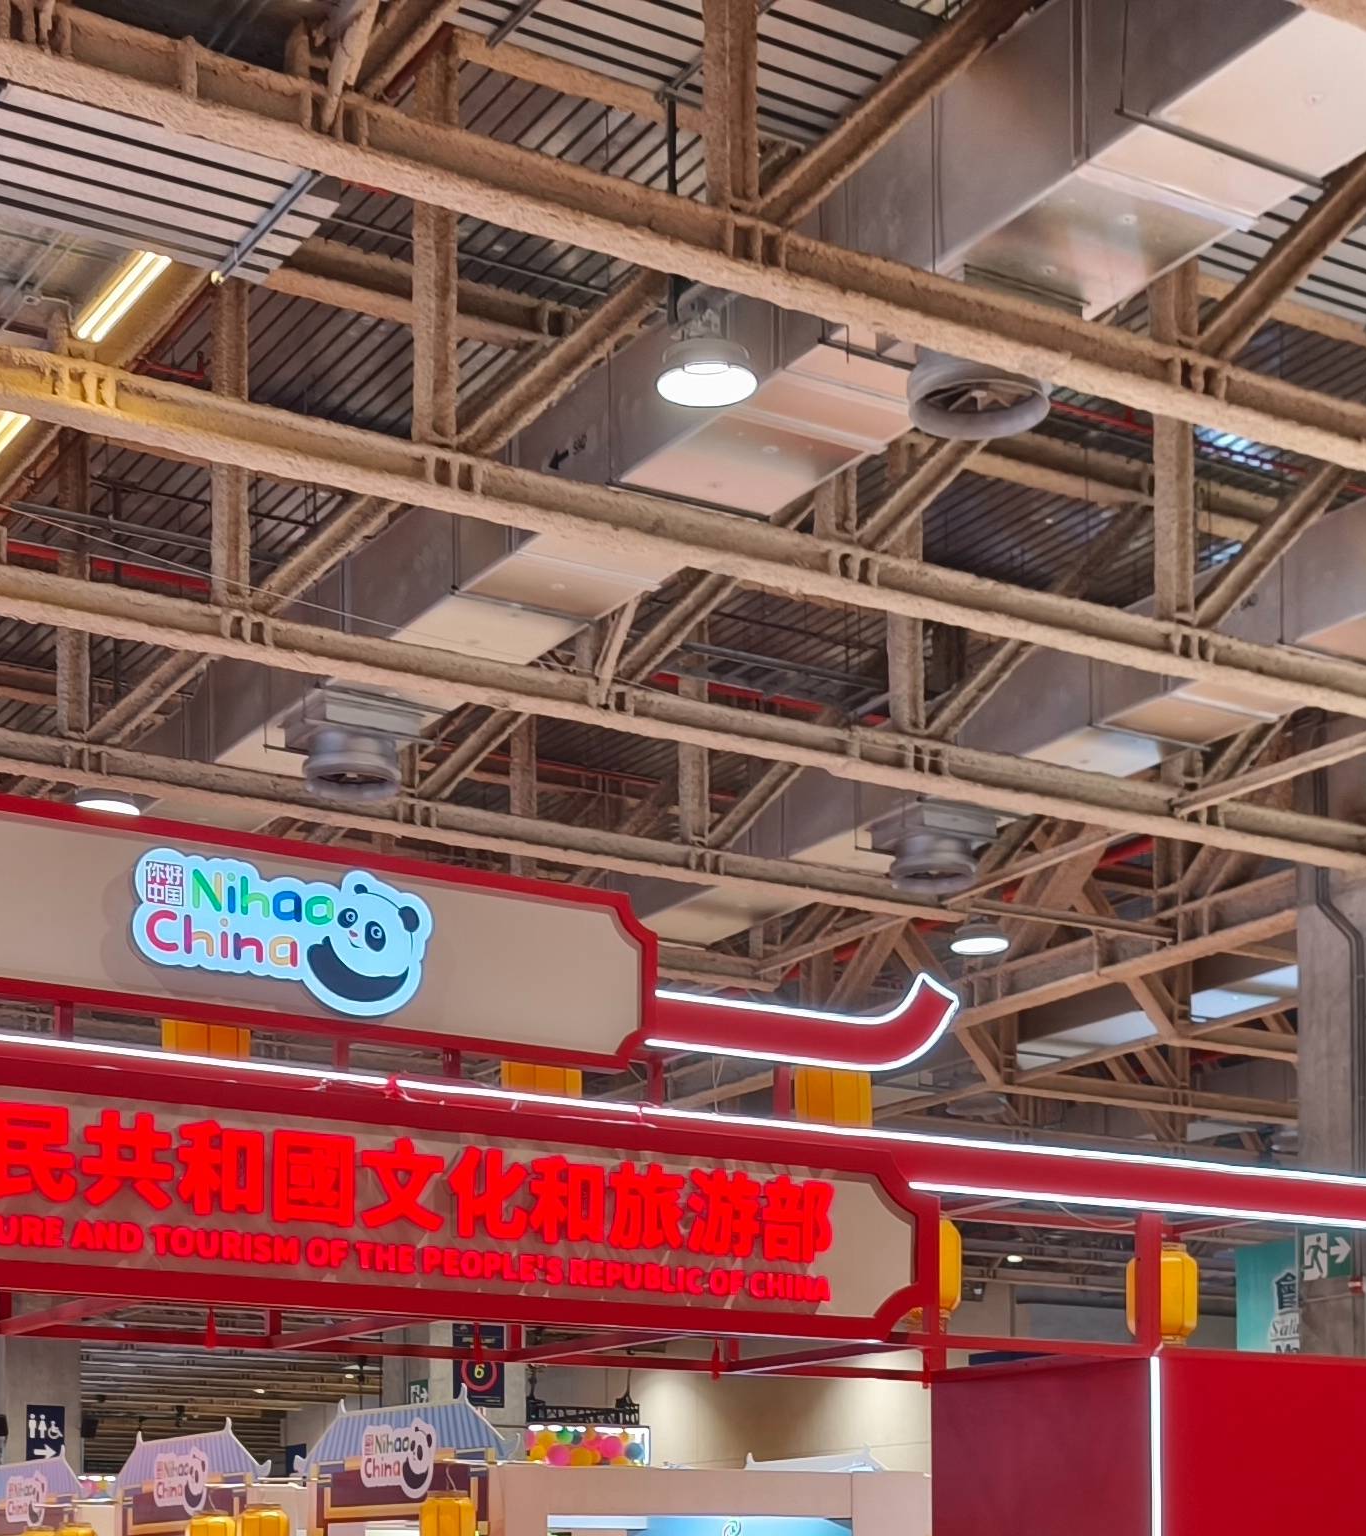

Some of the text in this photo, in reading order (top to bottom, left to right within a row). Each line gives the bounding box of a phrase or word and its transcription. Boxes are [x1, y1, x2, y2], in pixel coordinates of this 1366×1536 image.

[145, 861, 184, 885] 你好
[146, 882, 184, 907] 中国
[192, 868, 334, 926] Nihao
[146, 909, 299, 968] China
[70, 1220, 143, 1253] AND
[151, 1224, 299, 1267] TOURISM
[306, 1236, 348, 1271] OF
[355, 1240, 415, 1275] THE
[421, 1245, 564, 1288] PEOPLE'S
[568, 1256, 704, 1296] REPUBLIC
[708, 1267, 745, 1298] OF
[748, 1272, 832, 1303] CHINA
[375, 1432, 410, 1453] Nihao
[364, 1458, 401, 1479] China
